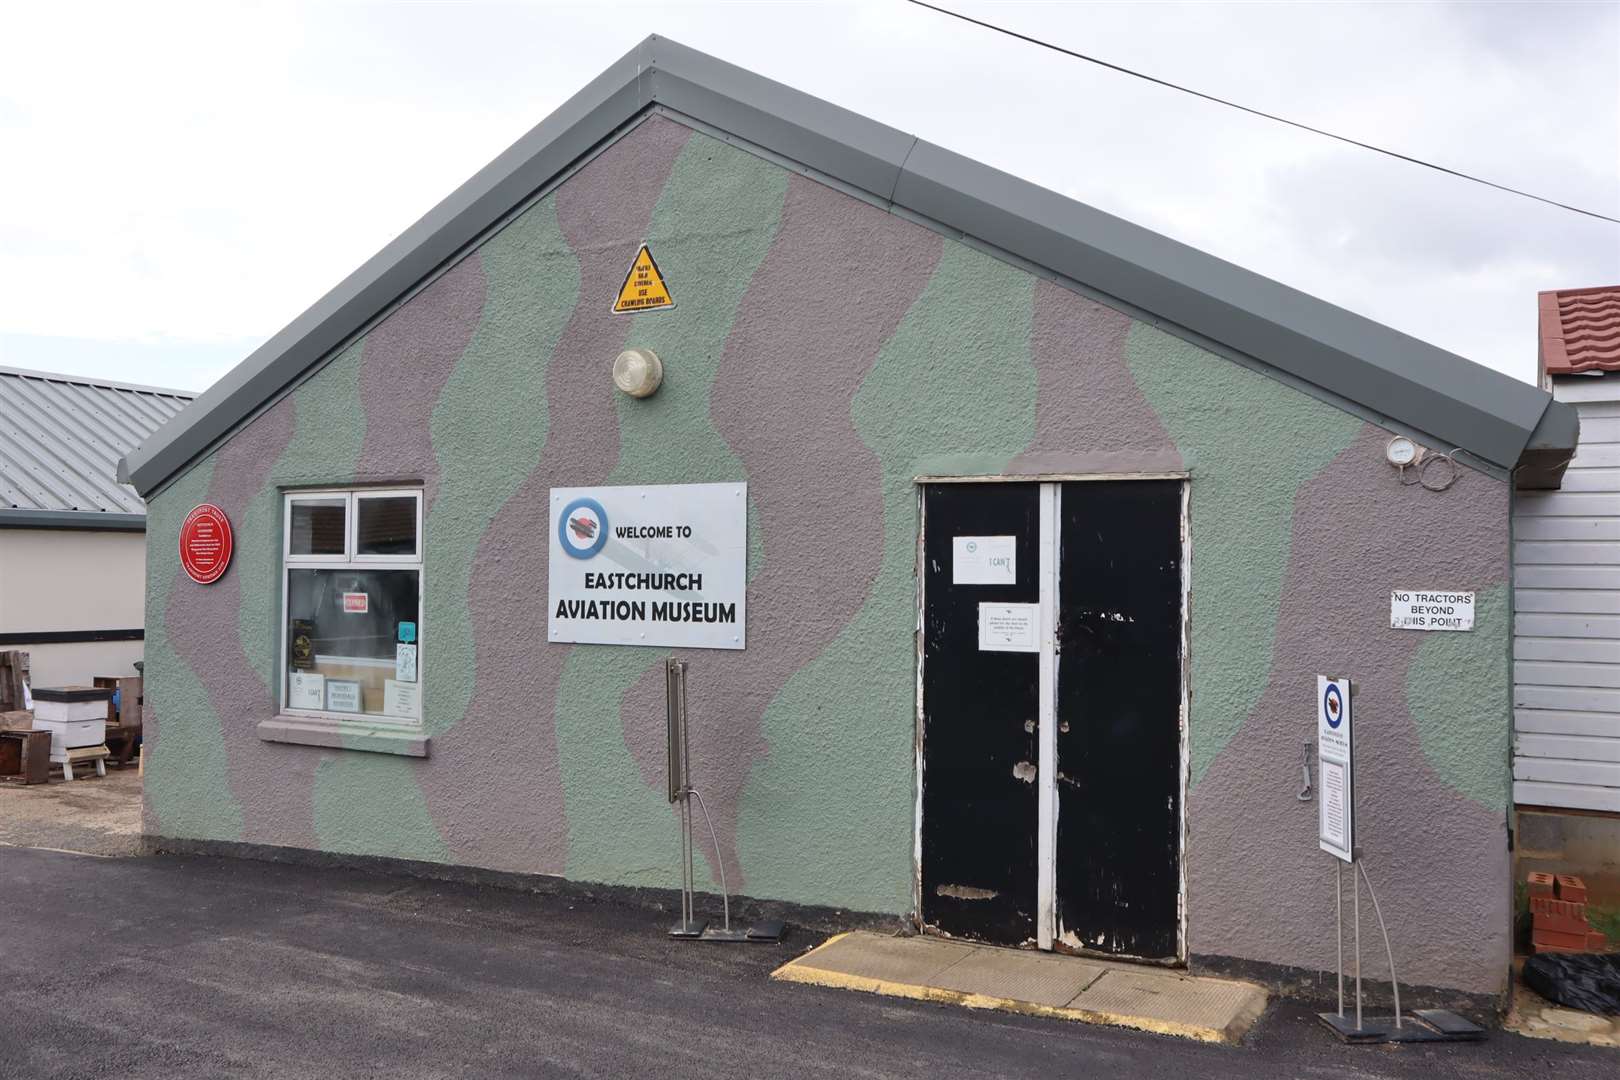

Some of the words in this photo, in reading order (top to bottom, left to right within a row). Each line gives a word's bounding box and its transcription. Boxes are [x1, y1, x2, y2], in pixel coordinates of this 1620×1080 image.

[616, 526, 673, 539] WELCOME
[676, 525, 692, 538] TO
[584, 572, 703, 591] EASTCHURCH
[1394, 593, 1410, 602] NO
[1415, 593, 1472, 604] TRACTORS
[555, 599, 646, 621] AVIATION
[651, 601, 736, 623] MUSEUM
[1411, 605, 1455, 615] BEYOND
